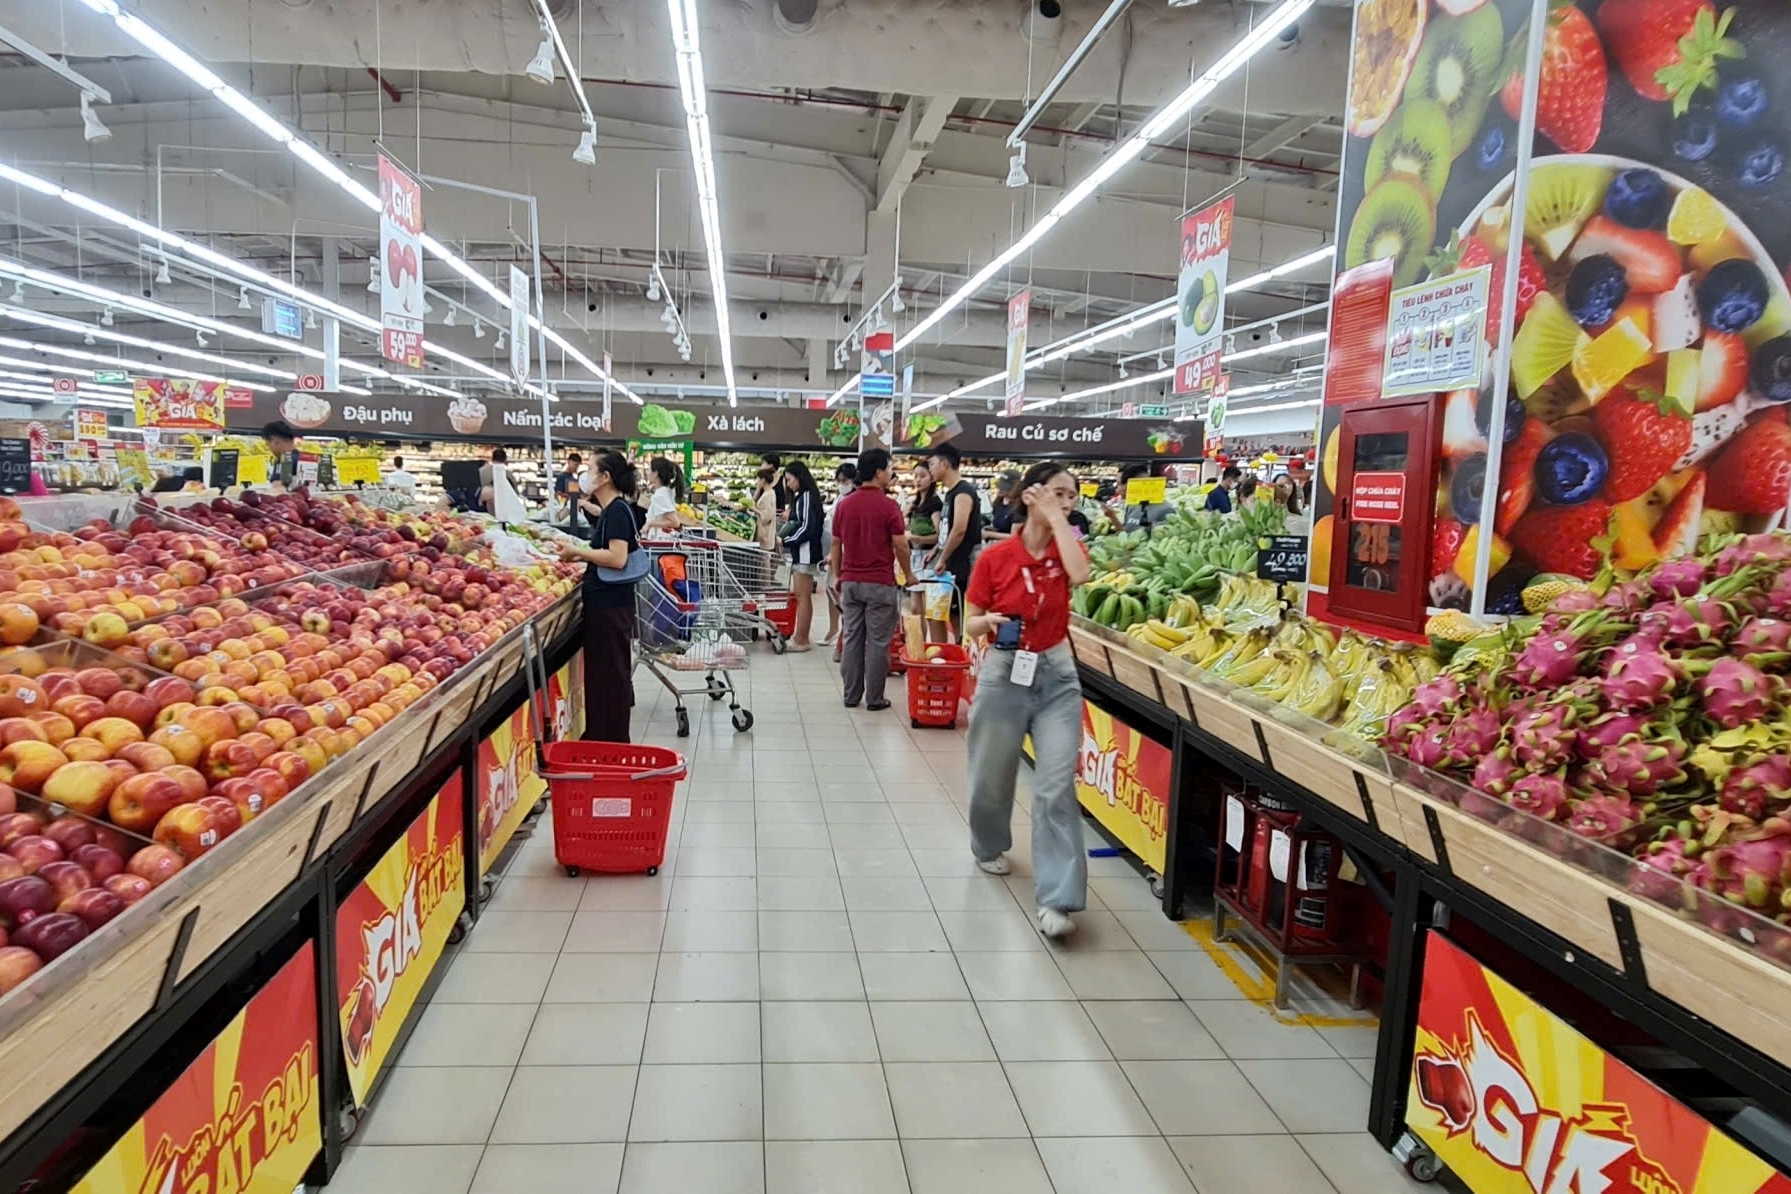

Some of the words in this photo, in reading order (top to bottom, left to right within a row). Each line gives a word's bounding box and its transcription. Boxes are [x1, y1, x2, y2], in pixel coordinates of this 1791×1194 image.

[391, 179, 413, 226] GIÁ
[1196, 211, 1222, 250] GIÁ
[343, 405, 377, 424] Đậu
[381, 407, 412, 425] phụ
[503, 408, 542, 426] Nấm
[549, 411, 573, 427] các
[707, 415, 729, 430] Xà
[732, 415, 765, 431] lách
[985, 424, 1017, 439] Rau
[1021, 423, 1044, 440] Củ
[1048, 428, 1069, 441] sơ
[1072, 425, 1105, 442] chế
[1082, 726, 1118, 807] GIÁ
[363, 862, 421, 1012] GIÁ
[419, 838, 443, 925] BẤT
[1467, 1014, 1638, 1194] GIÁ
